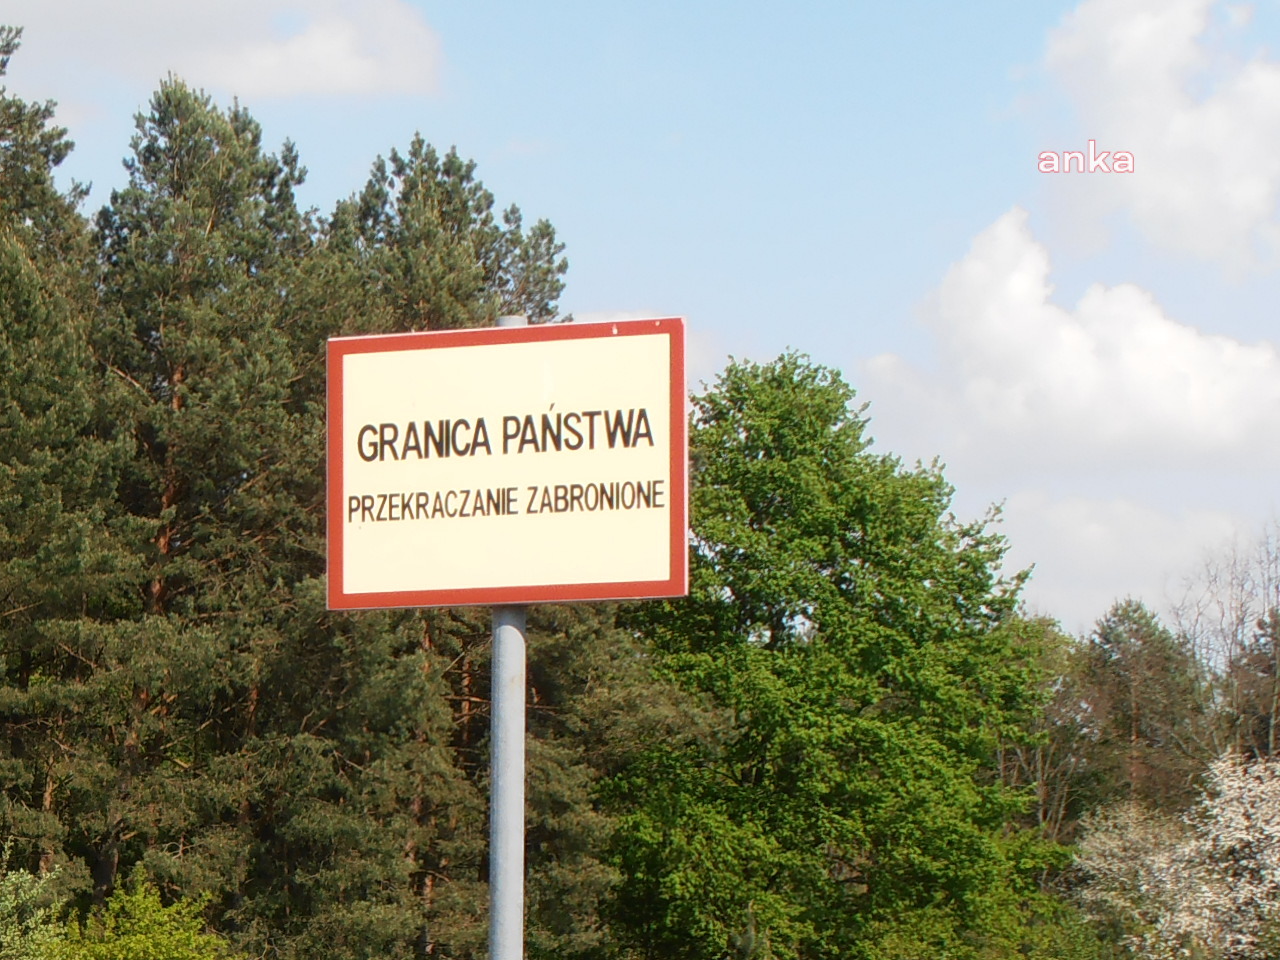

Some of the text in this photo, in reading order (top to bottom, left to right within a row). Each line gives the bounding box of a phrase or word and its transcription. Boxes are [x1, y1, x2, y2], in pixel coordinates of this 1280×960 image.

[357, 403, 655, 462] GRANICA PAŃSTWA
[348, 480, 665, 523] PRZEKRACZANIE ZABRONIONE
